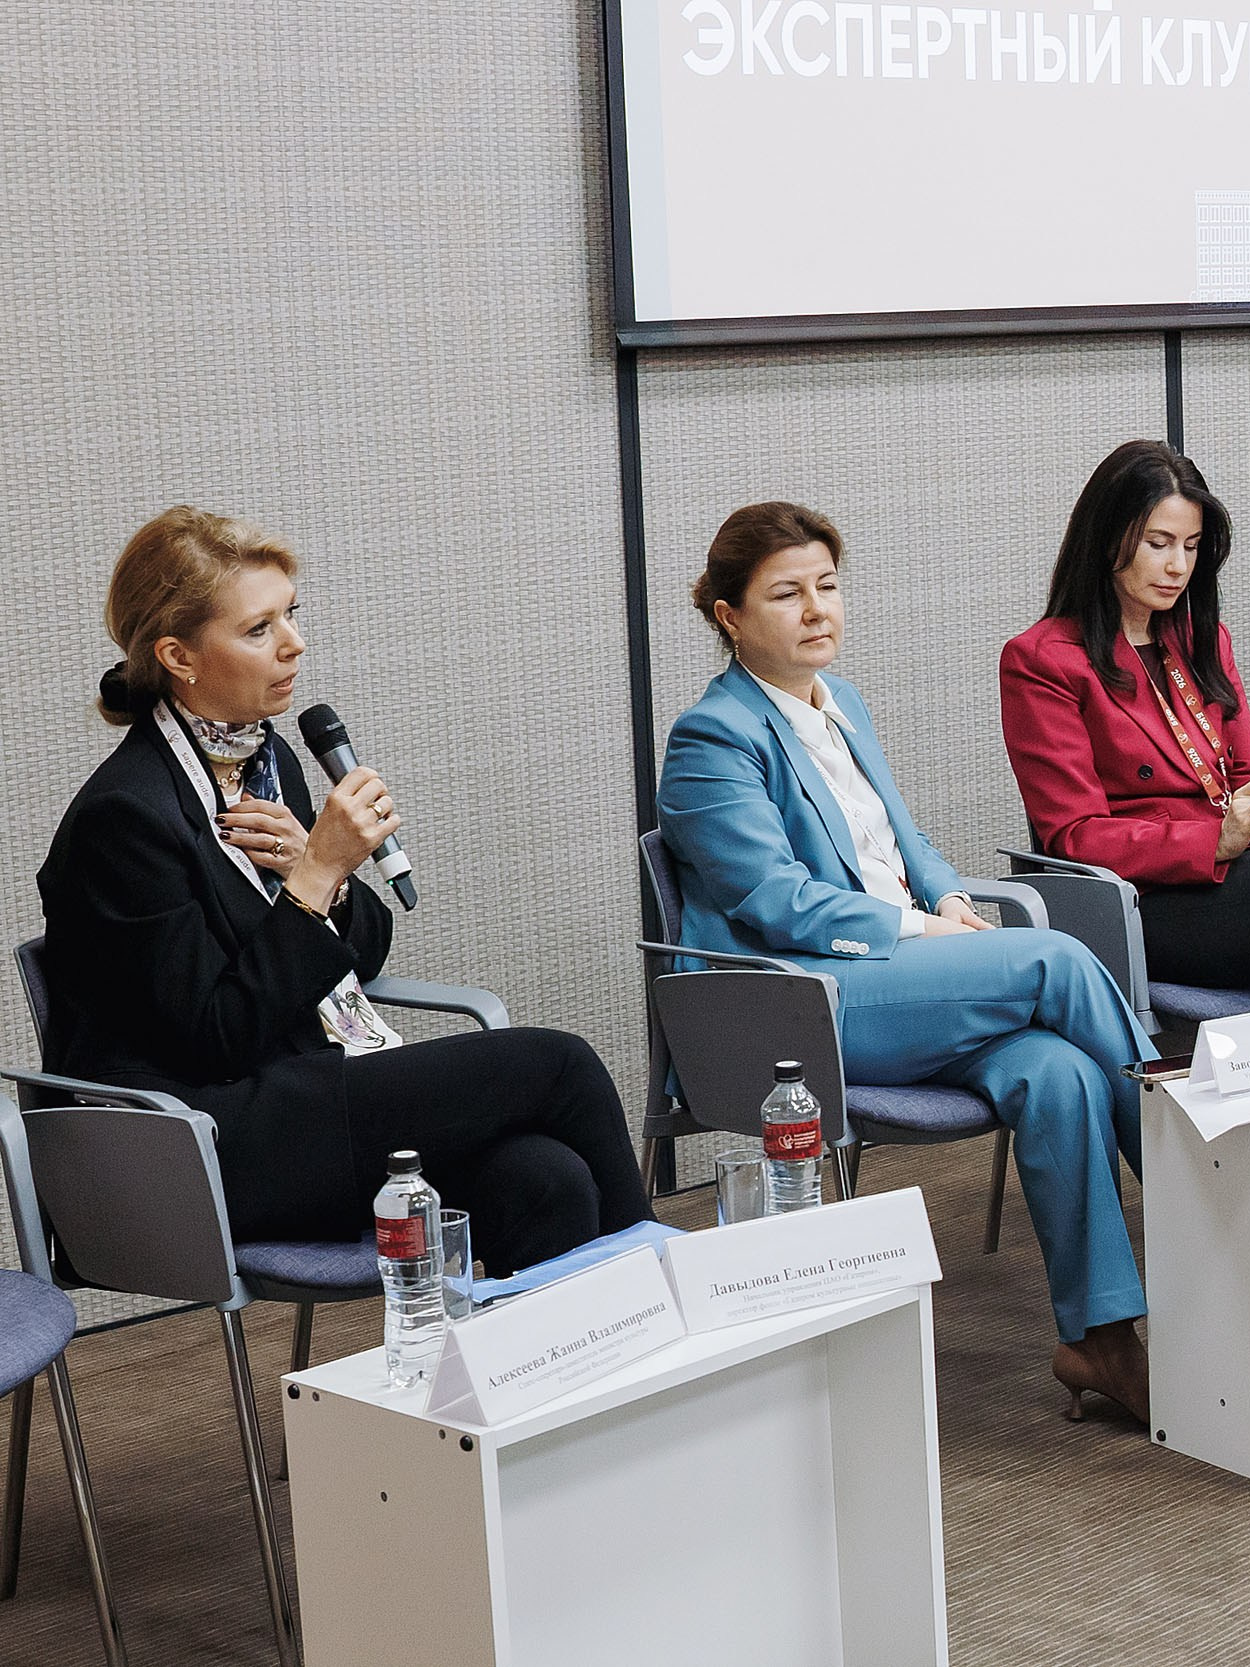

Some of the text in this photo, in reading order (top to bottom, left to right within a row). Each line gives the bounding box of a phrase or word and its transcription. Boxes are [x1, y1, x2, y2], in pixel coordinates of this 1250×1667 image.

[681, 0, 1121, 84] ЭКСПЕРТНЫЙ
[1170, 669, 1187, 689] 2026
[1196, 711, 1210, 731] БКФ
[181, 751, 210, 798] sapere aude
[1187, 748, 1204, 768] 2026
[235, 854, 251, 871] aude
[709, 1247, 907, 1300] Давыдова Елена Георгиевна
[488, 1355, 547, 1390] Алексеева
[546, 1338, 588, 1362] Жанна
[588, 1301, 666, 1344] Владимировна
